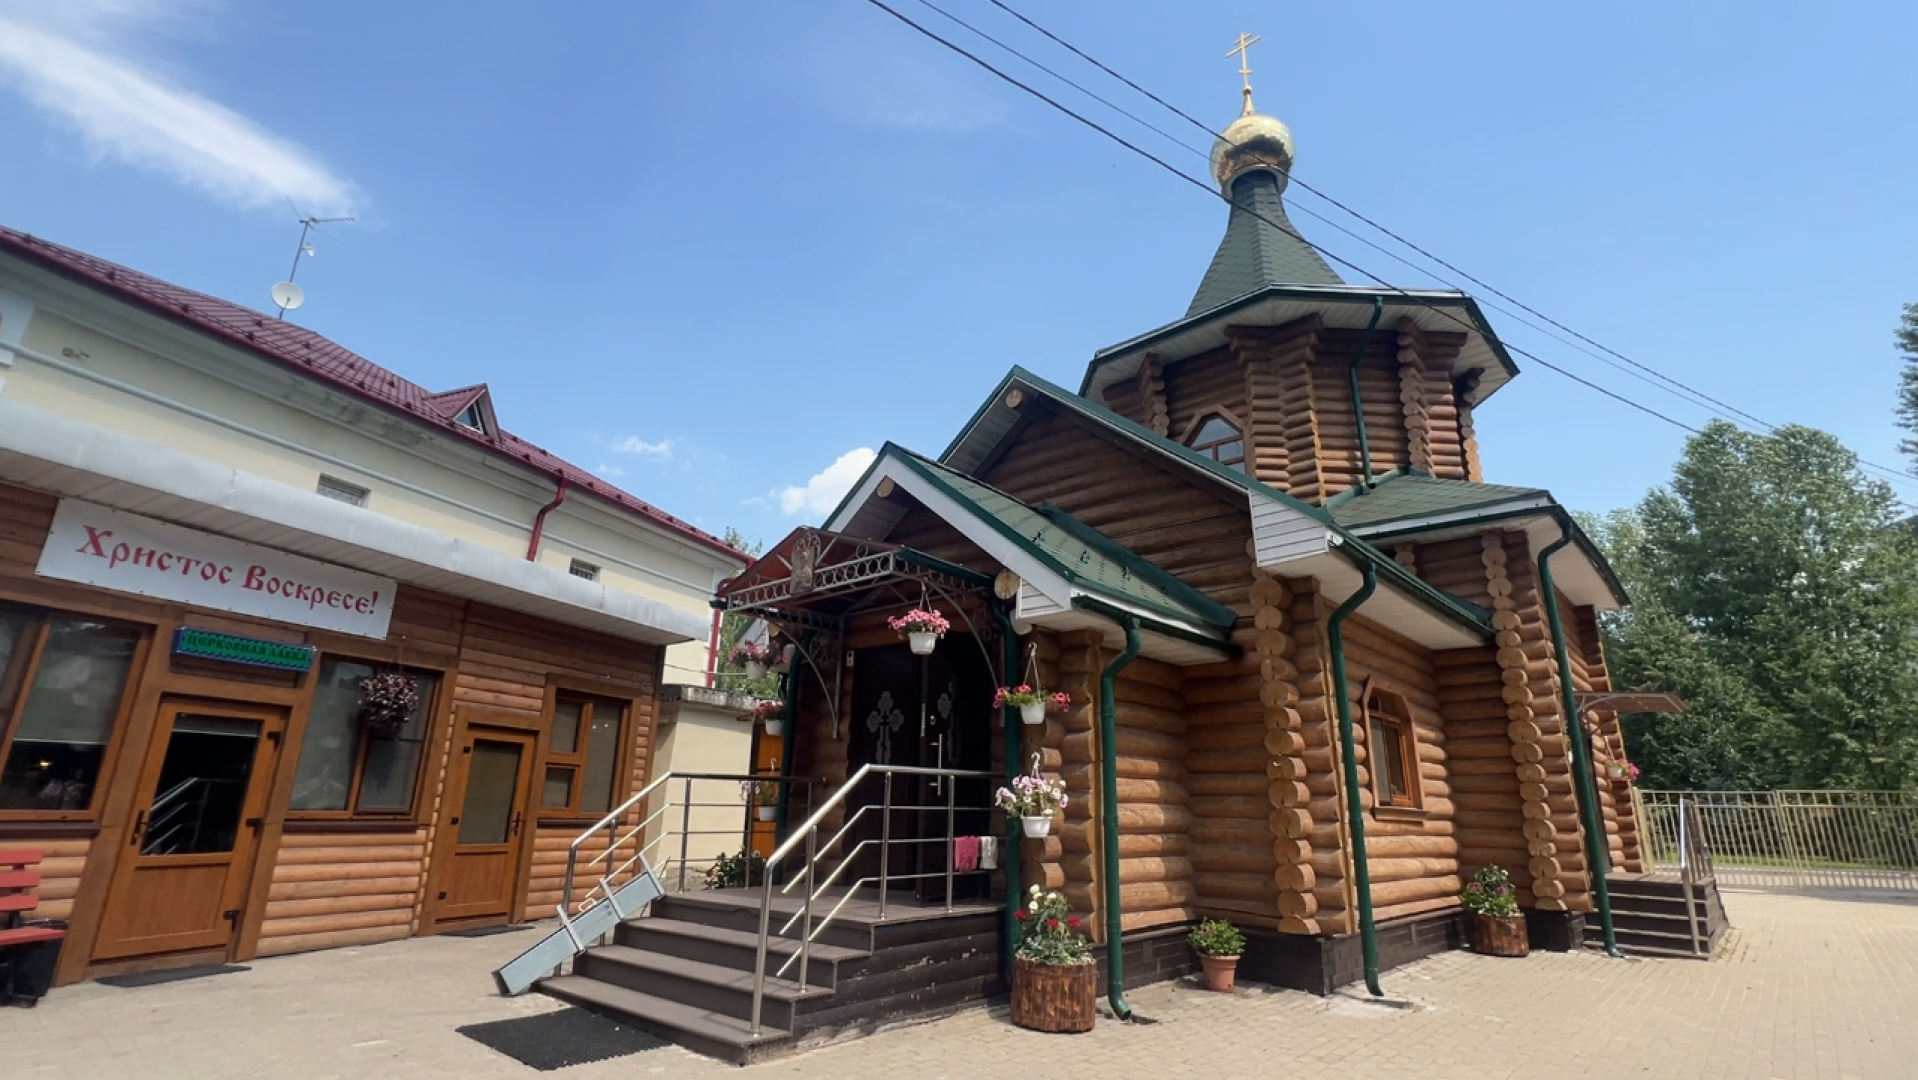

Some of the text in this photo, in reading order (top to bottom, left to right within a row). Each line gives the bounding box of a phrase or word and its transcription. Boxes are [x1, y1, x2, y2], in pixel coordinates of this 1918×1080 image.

[76, 525, 379, 614] Христос Воскресе!
[187, 635, 306, 661] ЦЕРКОВНАЯ ЛАВКА
